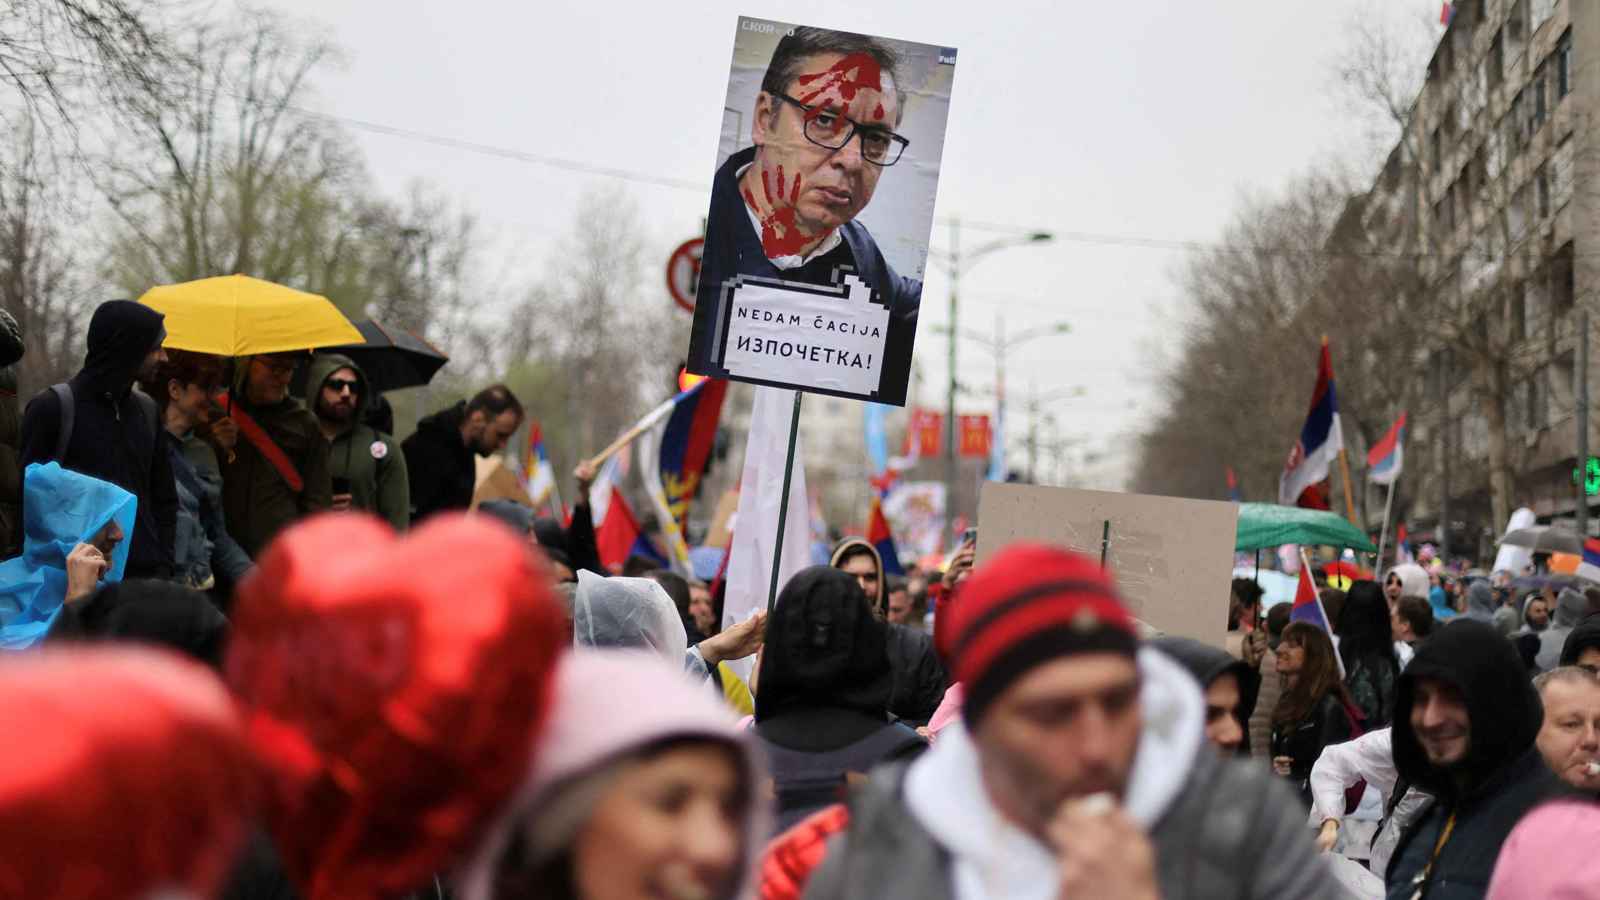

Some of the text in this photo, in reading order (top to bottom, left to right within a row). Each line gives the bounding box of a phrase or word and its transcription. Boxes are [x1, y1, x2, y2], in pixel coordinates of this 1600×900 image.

[737, 307, 881, 338] NEDAM ČACIJA
[737, 335, 873, 370] ИЗПОЧЕТКА!
